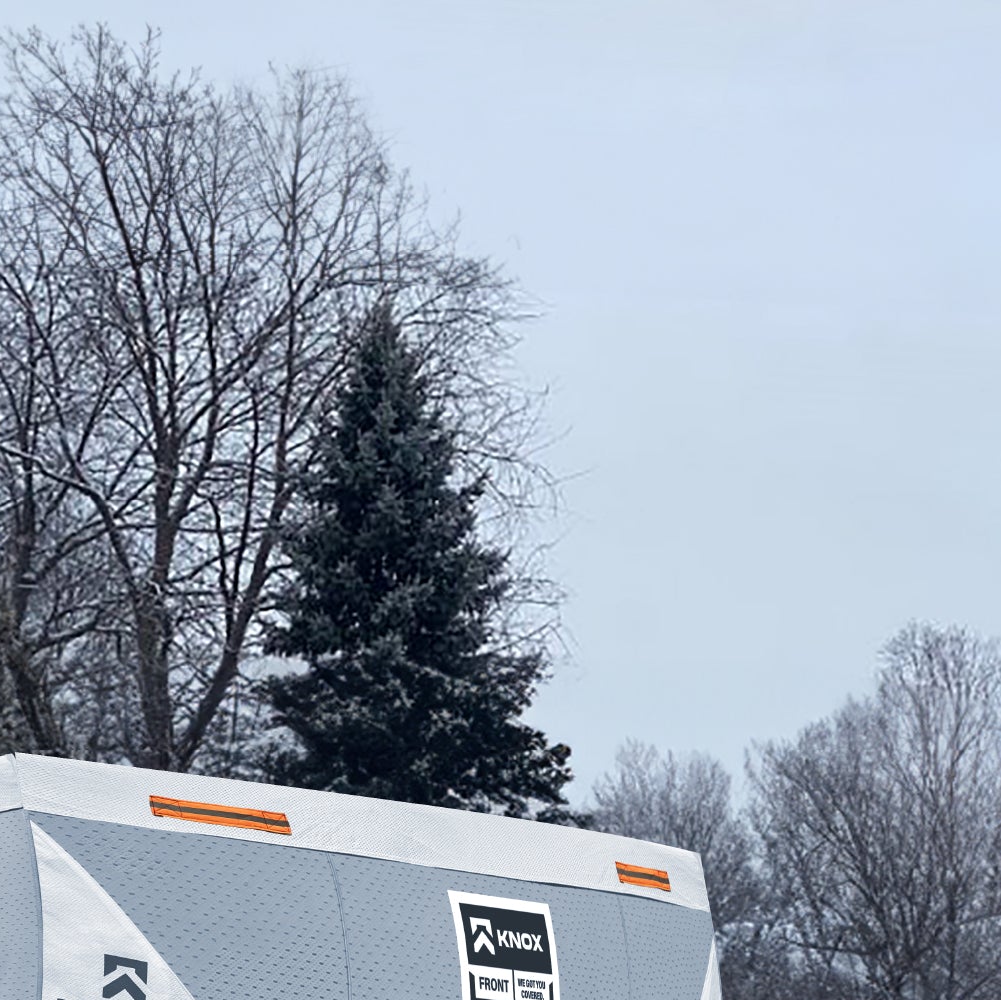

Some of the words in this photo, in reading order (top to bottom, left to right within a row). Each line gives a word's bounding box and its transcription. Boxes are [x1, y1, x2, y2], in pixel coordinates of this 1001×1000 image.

[496, 929, 544, 953] KNOX
[479, 976, 509, 993] FRONT
[517, 978, 526, 988] WE
[526, 979, 536, 989] GOT
[535, 980, 546, 990] YOU
[521, 990, 545, 1000] COVERED.
